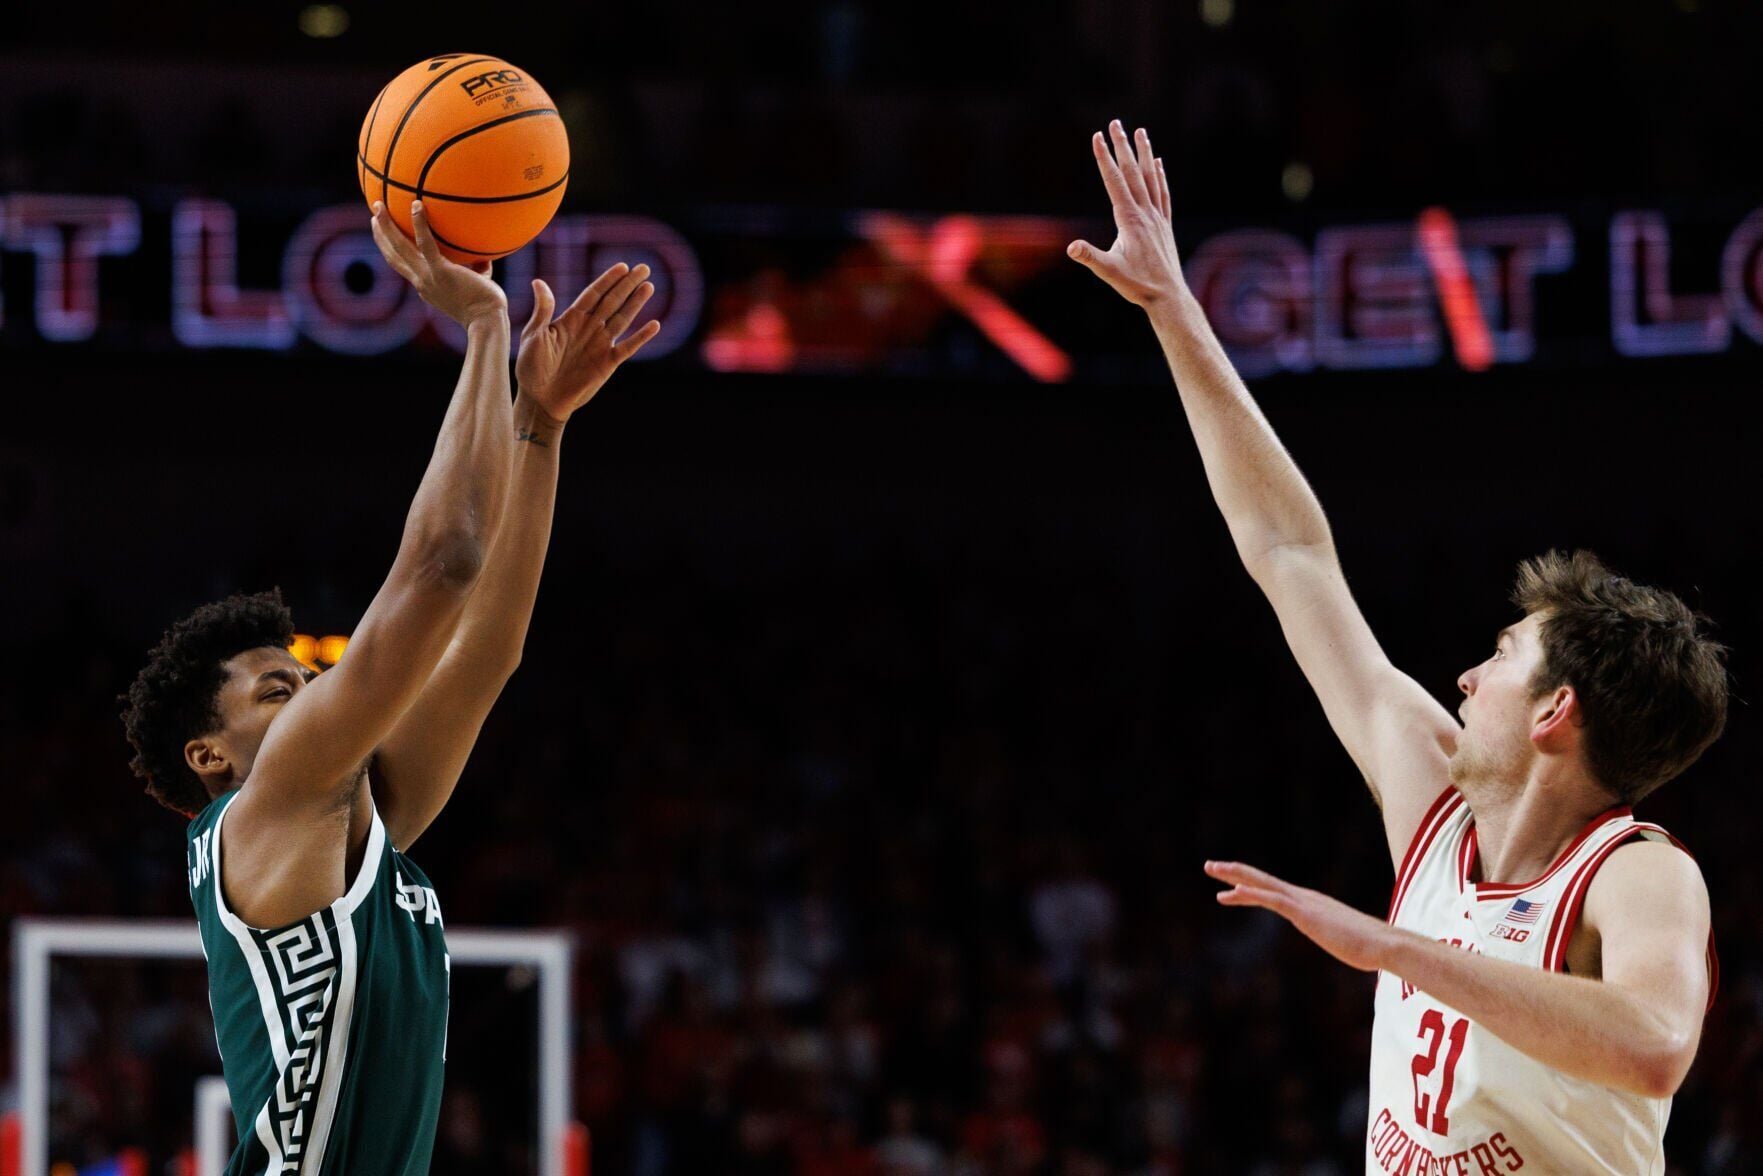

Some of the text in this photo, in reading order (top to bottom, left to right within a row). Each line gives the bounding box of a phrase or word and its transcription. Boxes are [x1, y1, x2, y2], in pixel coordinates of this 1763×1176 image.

[460, 70, 522, 97] PRO
[0, 193, 144, 342] T
[1183, 212, 1577, 377] GET
[1411, 1008, 1469, 1136] 21
[1371, 1108, 1524, 1176] CORNHKERS
